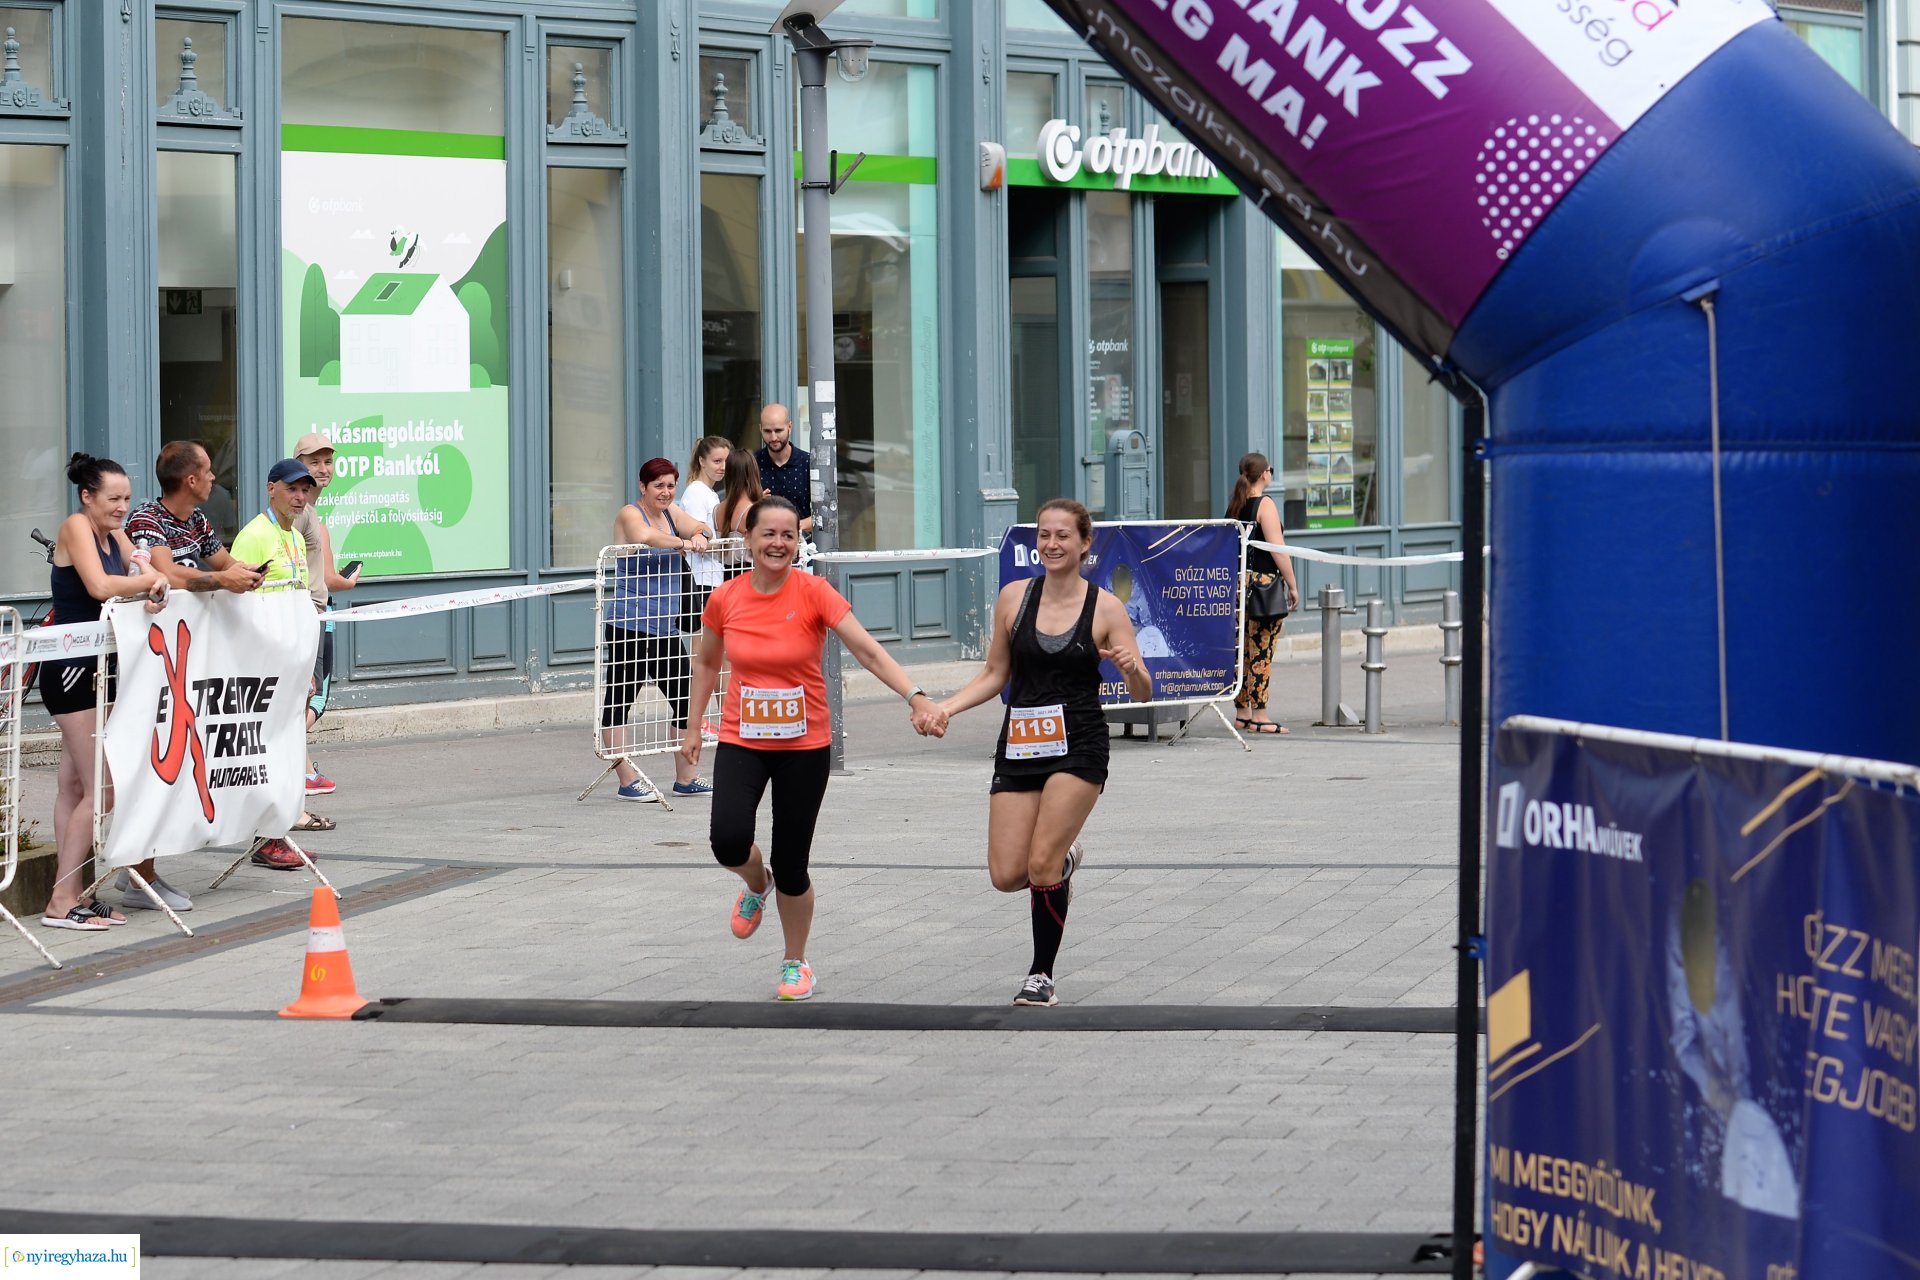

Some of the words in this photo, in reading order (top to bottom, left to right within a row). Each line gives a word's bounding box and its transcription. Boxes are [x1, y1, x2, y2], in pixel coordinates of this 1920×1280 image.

[1334, 0, 1473, 100] OZZ
[1216, 33, 1328, 150] MA!
[1096, 339, 1129, 355] otpbank
[335, 455, 370, 478] OTP
[373, 452, 441, 477] Banktól
[359, 490, 410, 507] támogatás
[381, 513, 387, 524] a
[334, 550, 358, 560] észletek:
[1162, 586, 1191, 600] HOGY
[1193, 585, 1205, 599] TE
[1206, 585, 1232, 598] VAGY
[1175, 604, 1184, 617] A
[1186, 603, 1232, 617] LEGJOBB
[746, 699, 799, 718] 1118
[205, 721, 267, 759] TRAIL
[208, 765, 258, 789] HUNGARY
[1804, 1050, 1917, 1132] GJOBB
[1634, 1242, 1651, 1280] A
